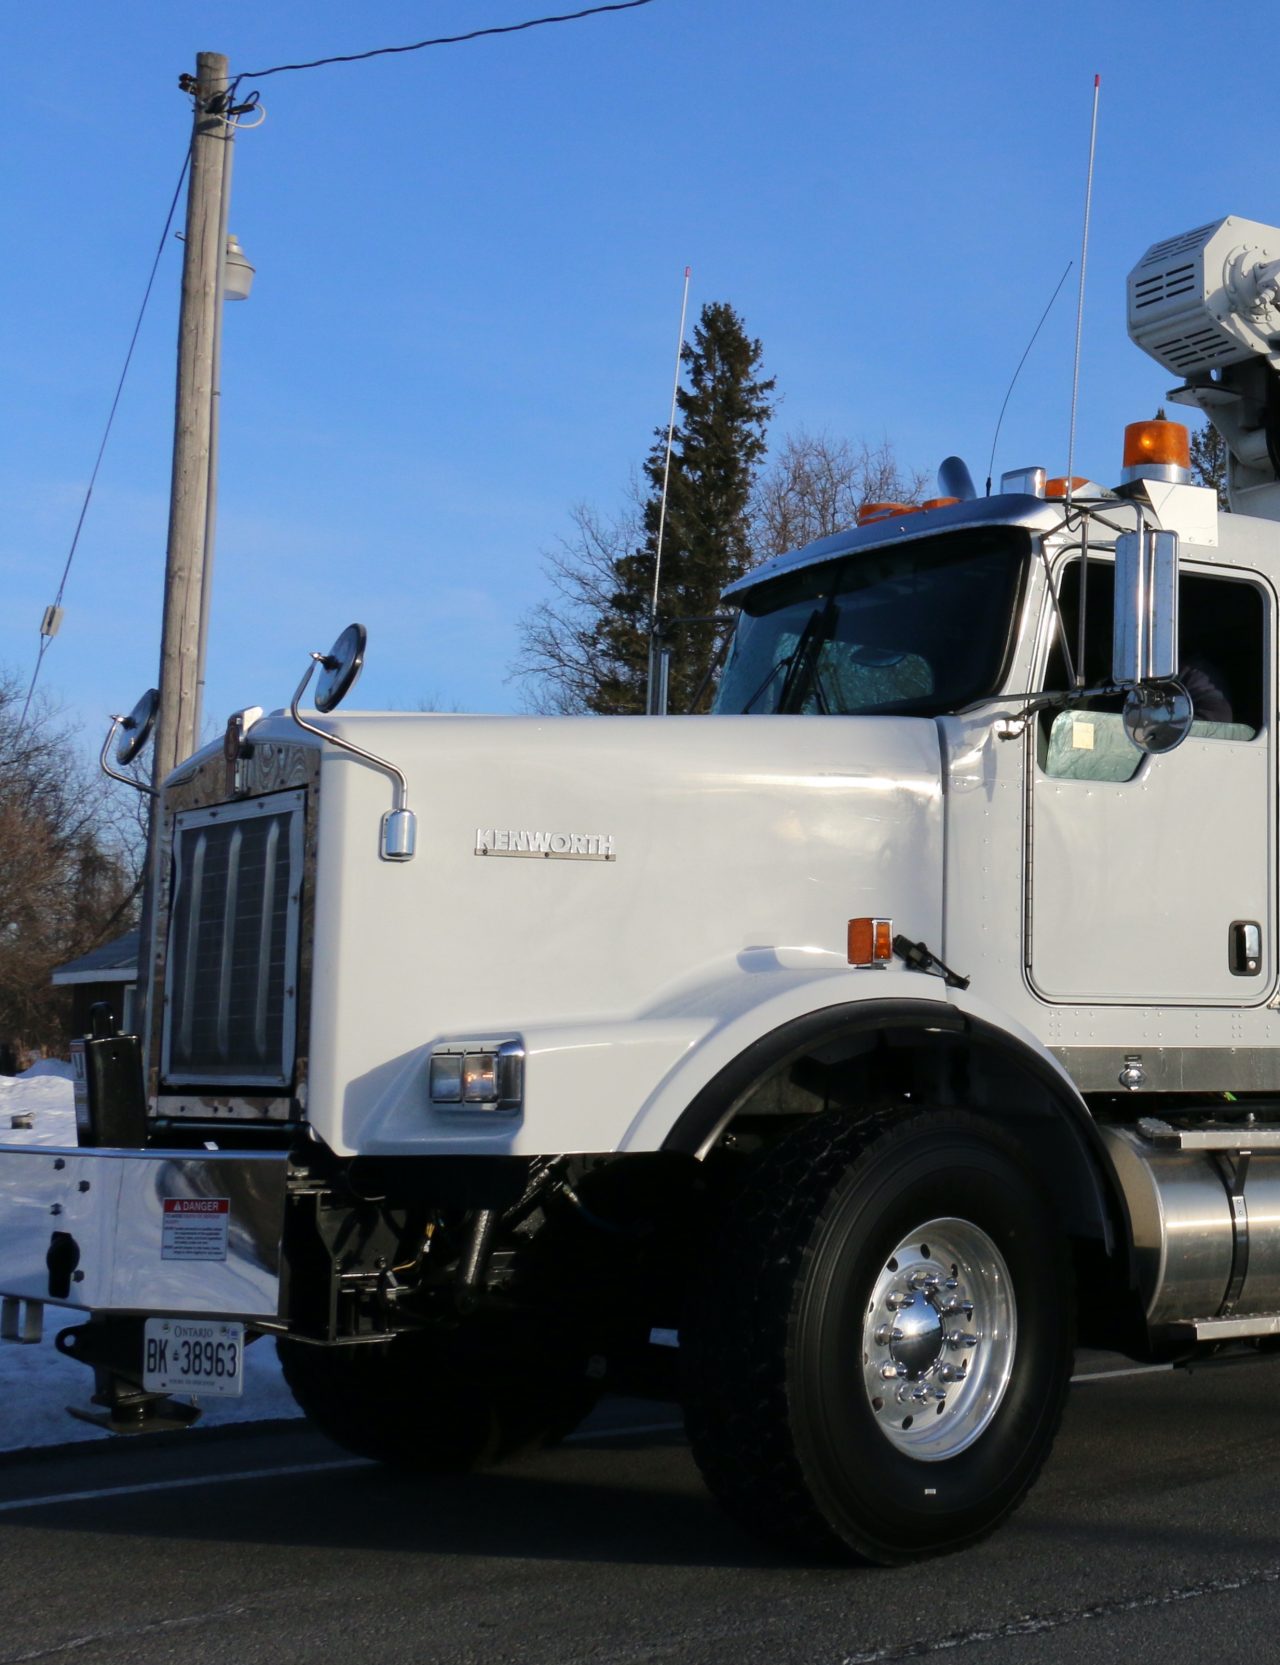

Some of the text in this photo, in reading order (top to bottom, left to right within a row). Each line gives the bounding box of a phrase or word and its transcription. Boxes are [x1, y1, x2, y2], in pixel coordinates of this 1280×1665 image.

[476, 828, 614, 855] KENWORTH
[183, 1201, 219, 1211] DANGER
[174, 1325, 214, 1338] ONTARIO
[146, 1338, 237, 1378] BK 38963
